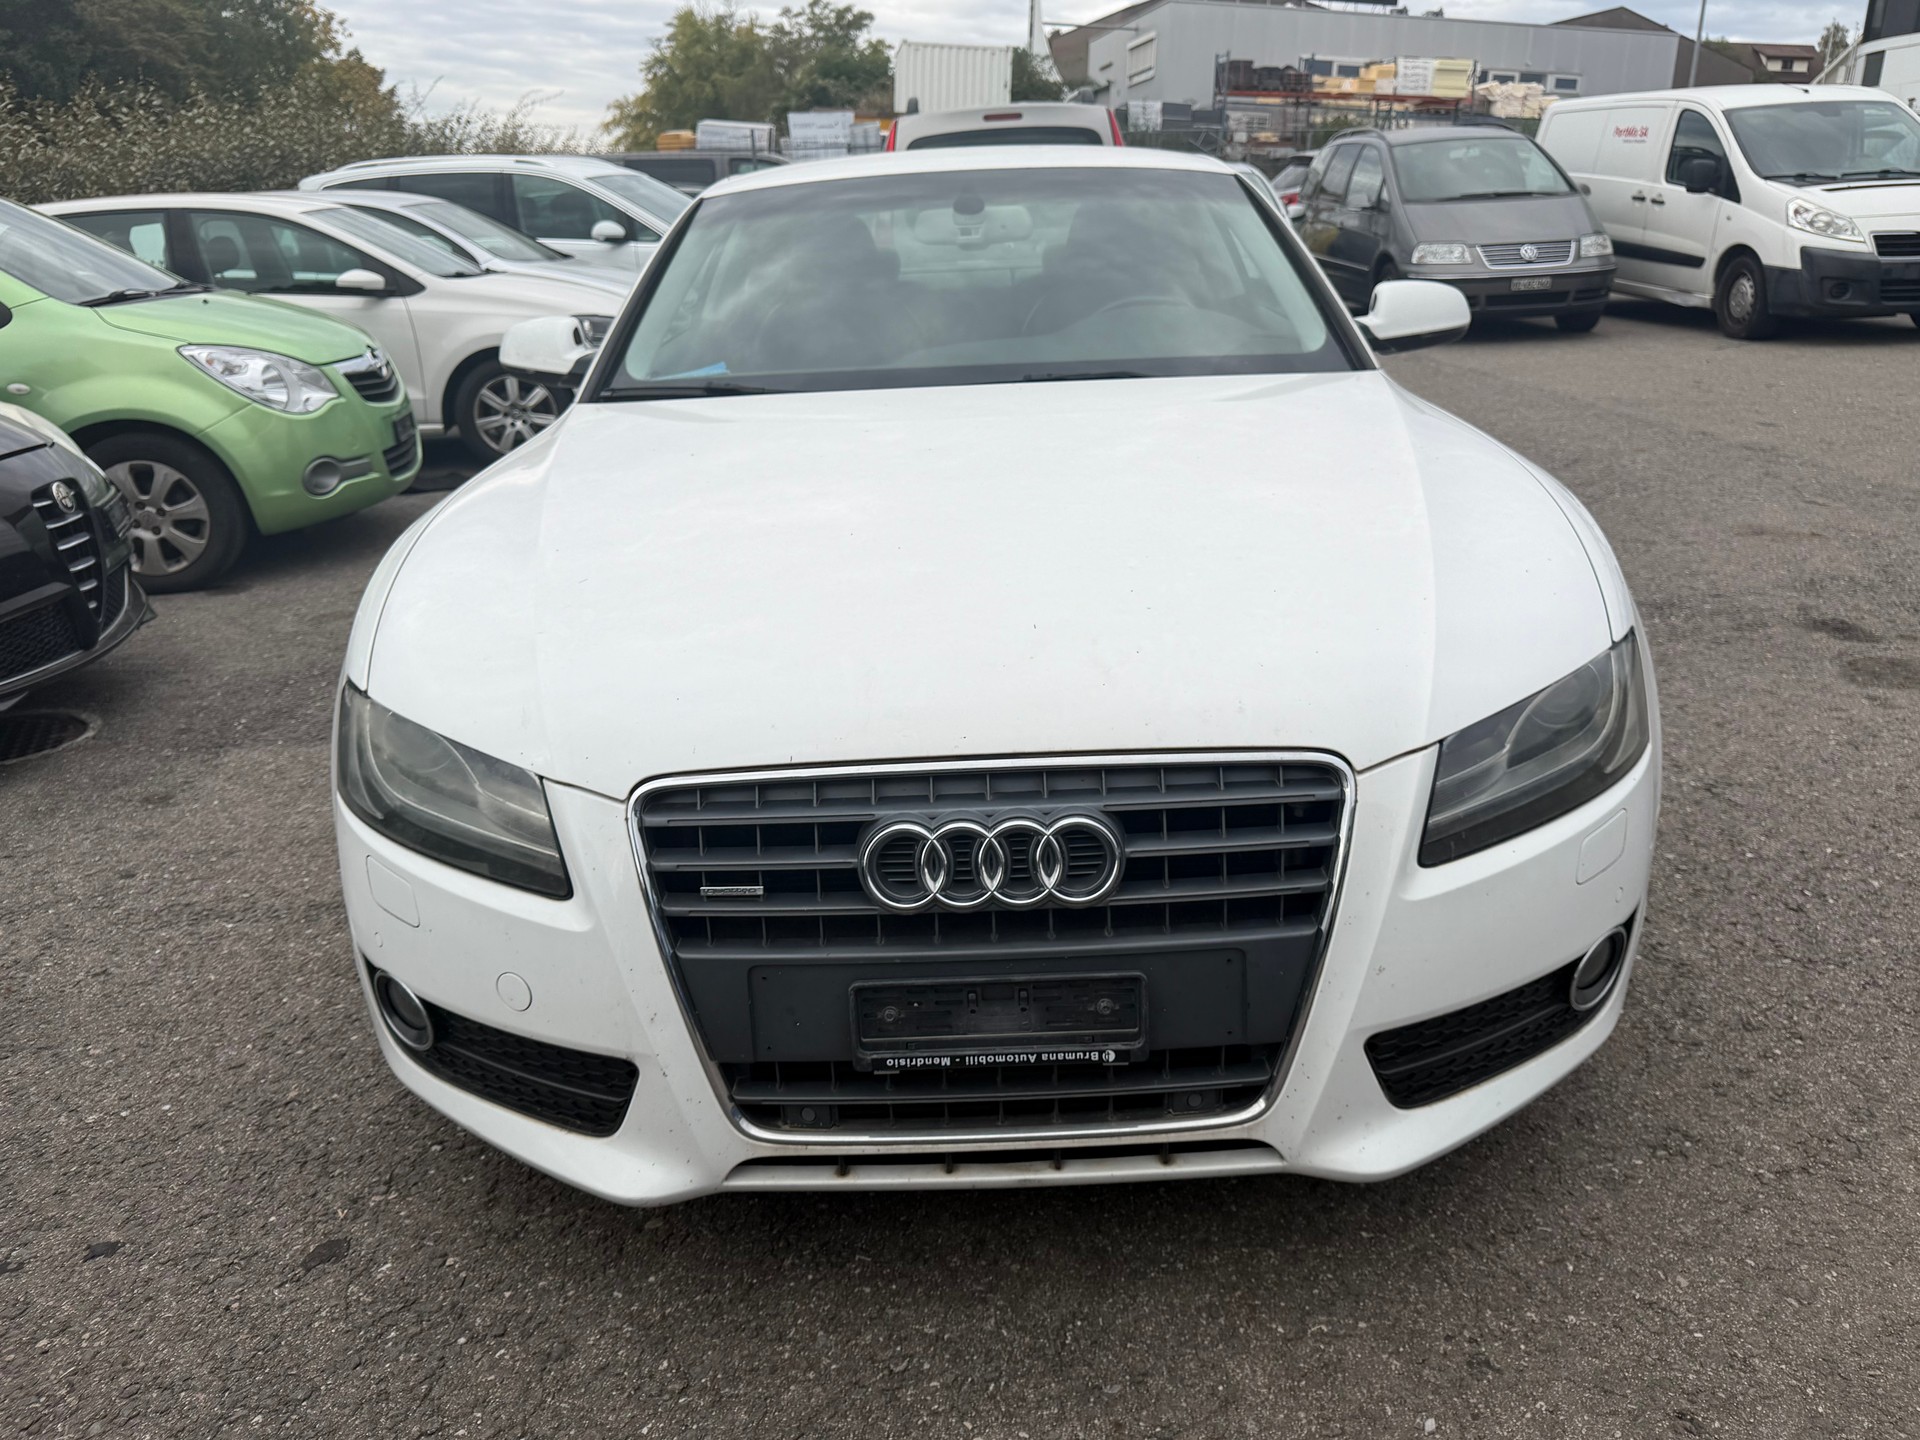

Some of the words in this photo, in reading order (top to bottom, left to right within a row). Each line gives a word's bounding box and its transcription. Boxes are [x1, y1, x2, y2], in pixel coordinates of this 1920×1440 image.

[885, 1056, 951, 1068] Mendrisio
[965, 1053, 1037, 1066] Automobili
[1041, 1051, 1099, 1062] Brumana
